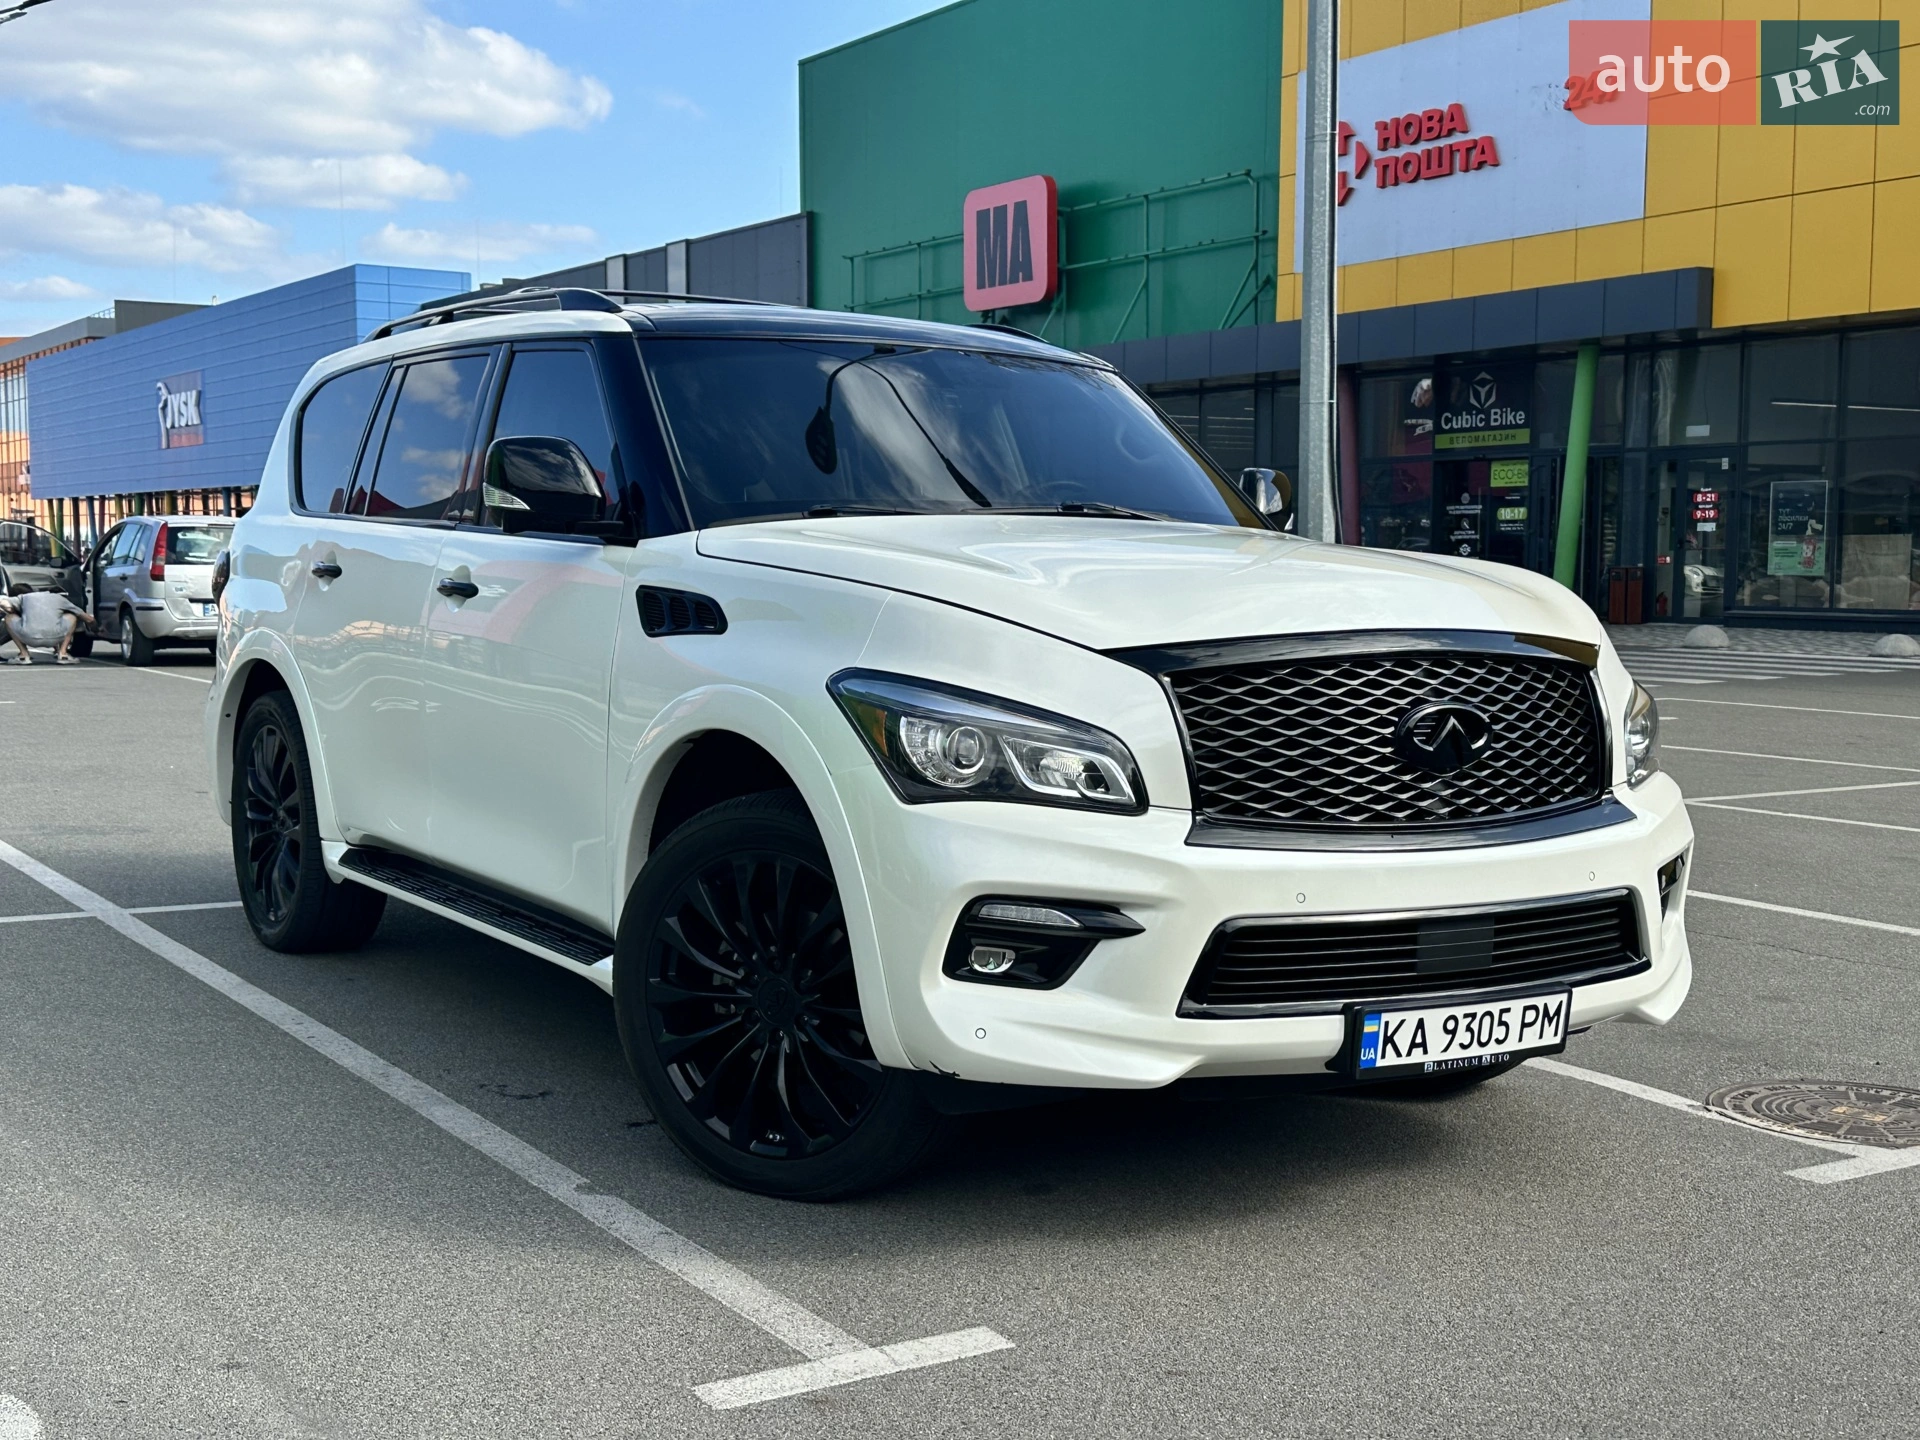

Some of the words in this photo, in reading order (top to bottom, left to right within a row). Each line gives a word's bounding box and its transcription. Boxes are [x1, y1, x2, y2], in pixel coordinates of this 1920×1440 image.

[1375, 103, 1469, 151] НОВА
[1374, 136, 1499, 189] ПОШТА
[166, 390, 202, 429] JYSK
[1441, 410, 1486, 429] Cubic
[1490, 408, 1525, 426] Bike
[1449, 433, 1516, 445] ВЕЛОМАГАЗИН
[1696, 493, 1715, 502] 8-21
[1500, 508, 1524, 520] 10-17
[1695, 510, 1715, 519] 9-19
[1380, 1017, 1429, 1060] KA
[1440, 1007, 1511, 1053] 9305
[1518, 1000, 1563, 1043] PM
[1361, 1048, 1375, 1060] UA
[1424, 1058, 1479, 1073] PLATINUM
[1481, 1053, 1510, 1066] AUTO
